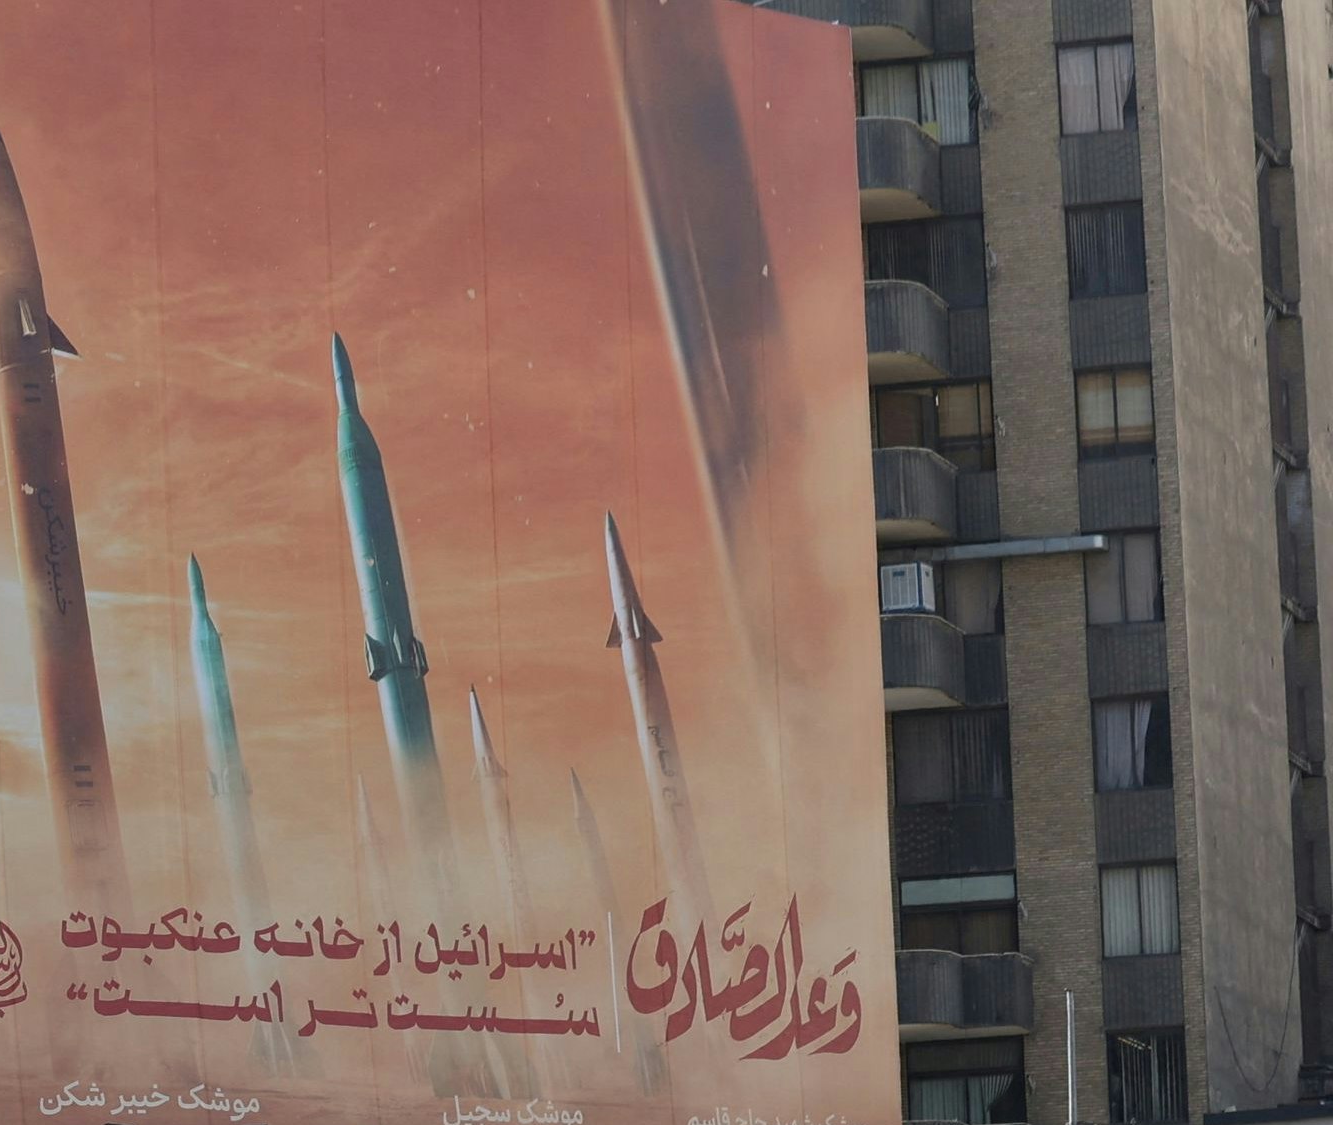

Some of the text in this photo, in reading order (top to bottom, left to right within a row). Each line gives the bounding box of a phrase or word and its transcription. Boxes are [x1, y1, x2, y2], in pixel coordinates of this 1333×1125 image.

[61, 907, 242, 966] عنکبوت
[253, 915, 365, 960] خانه
[372, 919, 403, 977] از
[297, 987, 379, 1038] تر
[39, 1080, 261, 1122] موشک خیبر شکن
